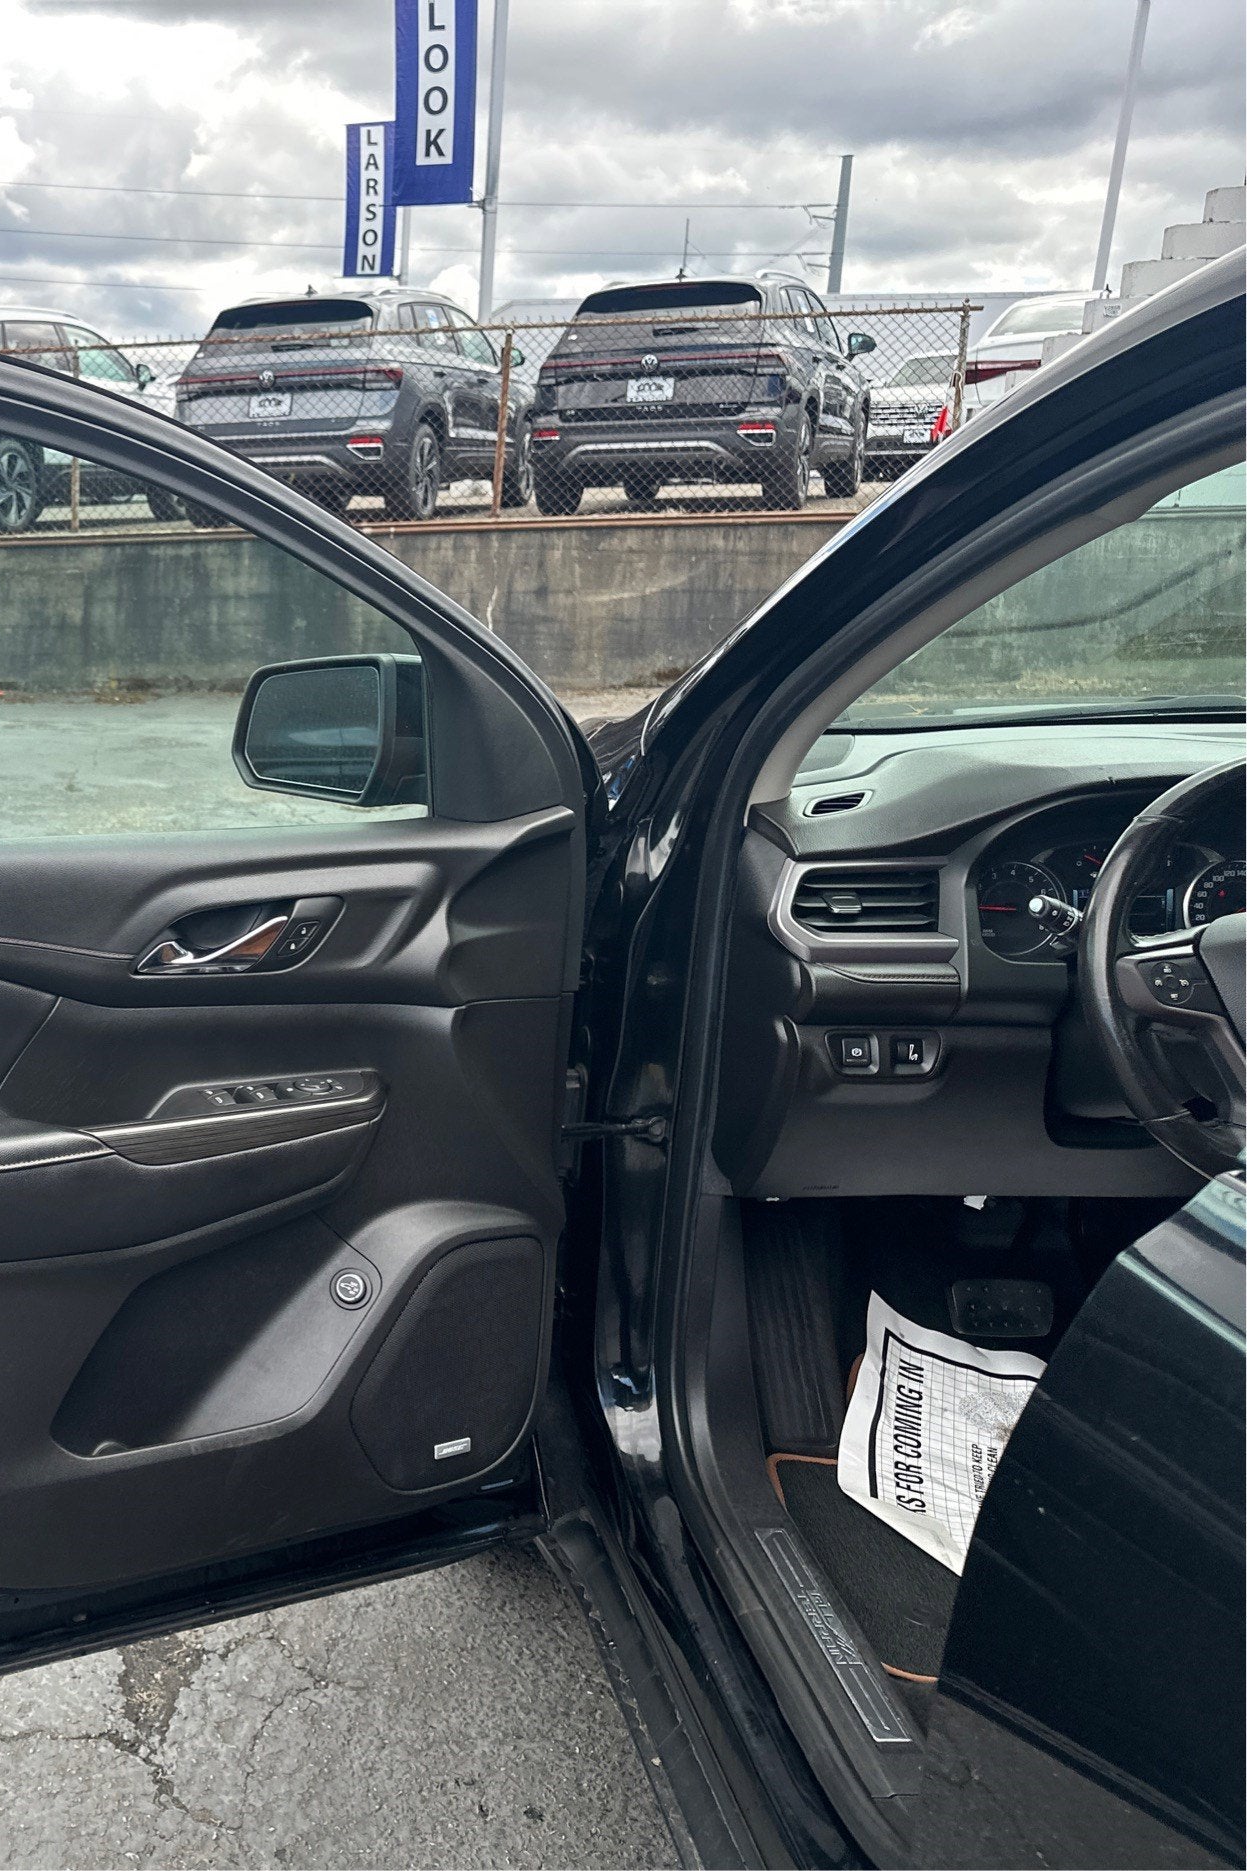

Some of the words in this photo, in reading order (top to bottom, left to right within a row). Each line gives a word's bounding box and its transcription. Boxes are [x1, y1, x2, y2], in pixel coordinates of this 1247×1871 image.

[423, 2, 449, 157] LOOK
[360, 129, 380, 272] LARSON
[898, 1358, 925, 1384] IN
[893, 1384, 924, 1459] COMING
[893, 1461, 925, 1495] FOR
[971, 1443, 983, 1464] KEEP
[971, 1464, 983, 1475] TO
[798, 1593, 849, 1665] TERRAIN
